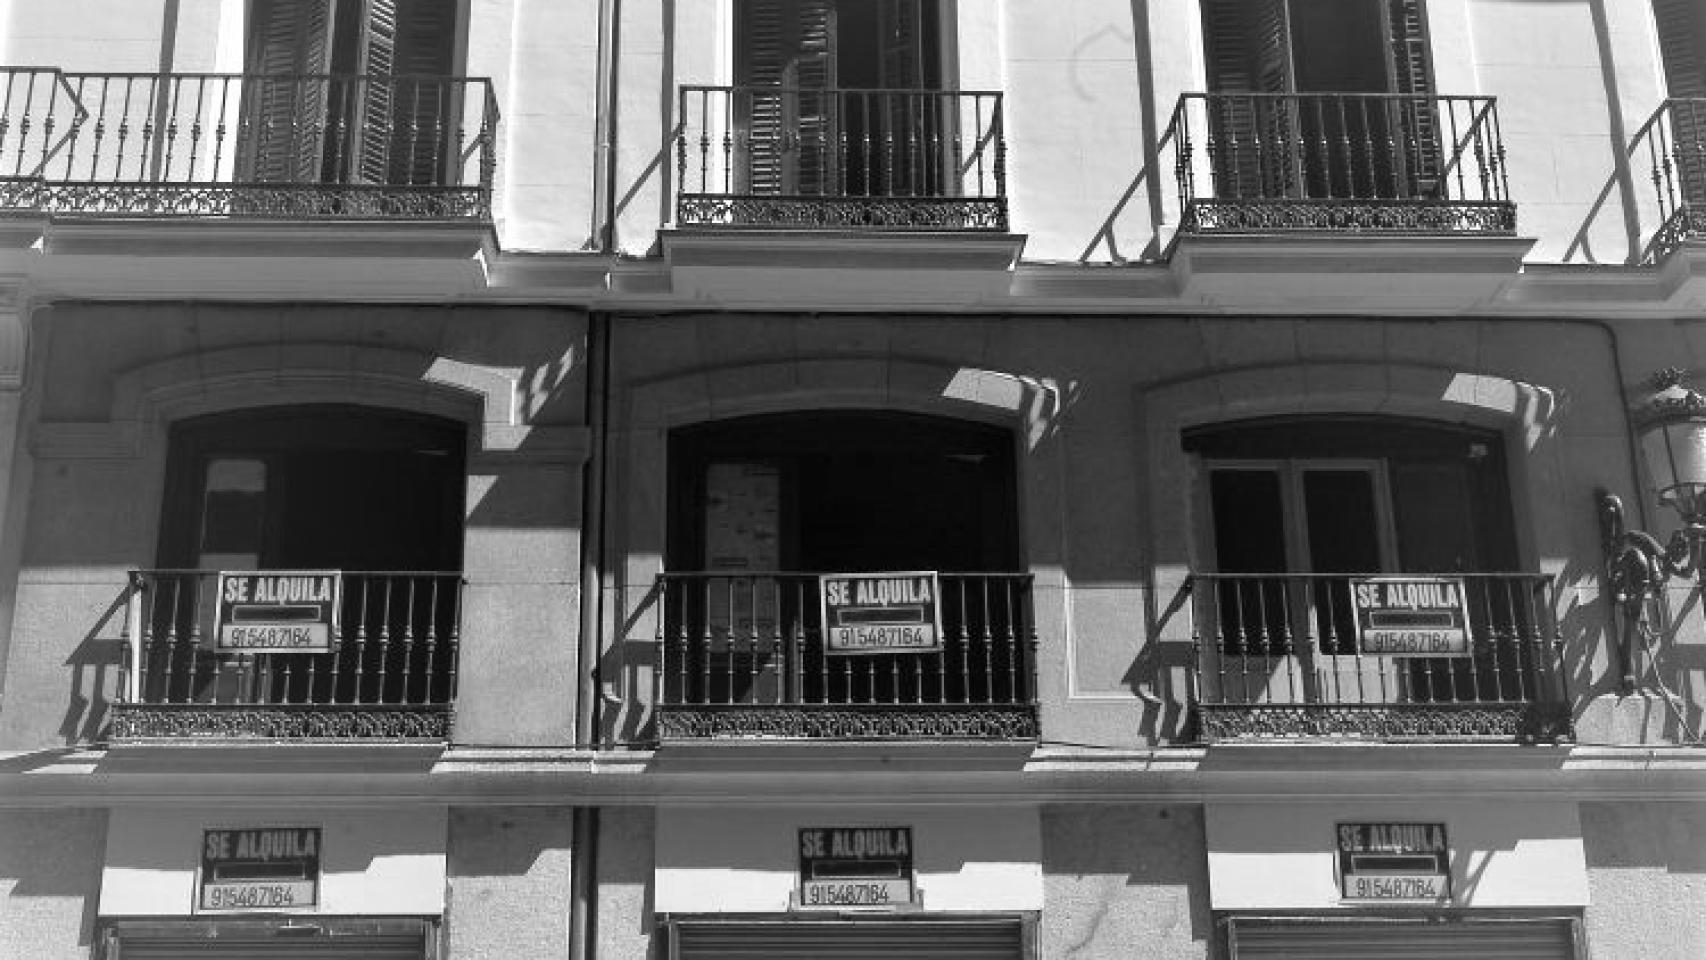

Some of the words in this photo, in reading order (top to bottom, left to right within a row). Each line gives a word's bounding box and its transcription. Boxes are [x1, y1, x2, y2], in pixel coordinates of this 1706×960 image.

[225, 577, 249, 602] SE
[254, 577, 331, 604] ALQUILA
[827, 581, 850, 606] SE
[856, 579, 931, 607] ALQUILA
[1357, 584, 1381, 608] SE
[1387, 583, 1459, 611] ALQUILA
[206, 832, 231, 858] SE
[236, 831, 315, 861] ALQUILA
[802, 832, 825, 857] SE
[832, 830, 908, 859] ALQUILA
[1341, 825, 1361, 851] SE
[1369, 825, 1445, 854] ALQUILA
